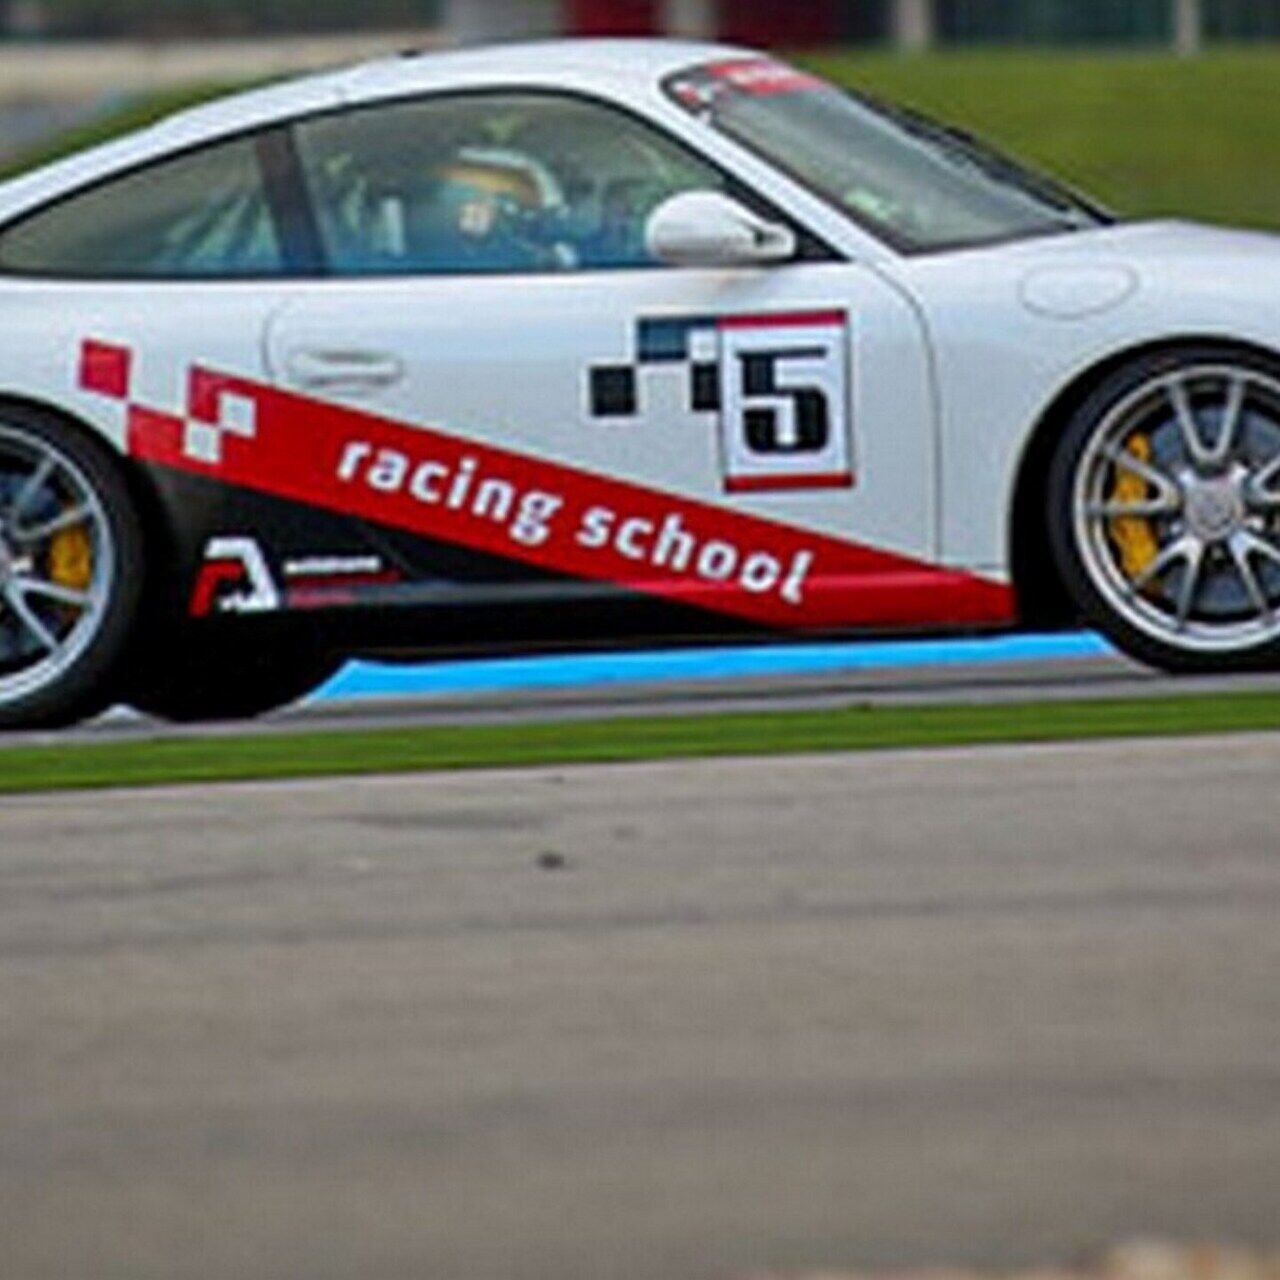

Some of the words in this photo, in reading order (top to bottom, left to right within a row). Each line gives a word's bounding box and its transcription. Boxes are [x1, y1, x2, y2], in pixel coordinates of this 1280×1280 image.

[736, 346, 830, 457] 5
[336, 440, 563, 546] racing
[576, 514, 814, 604] school
